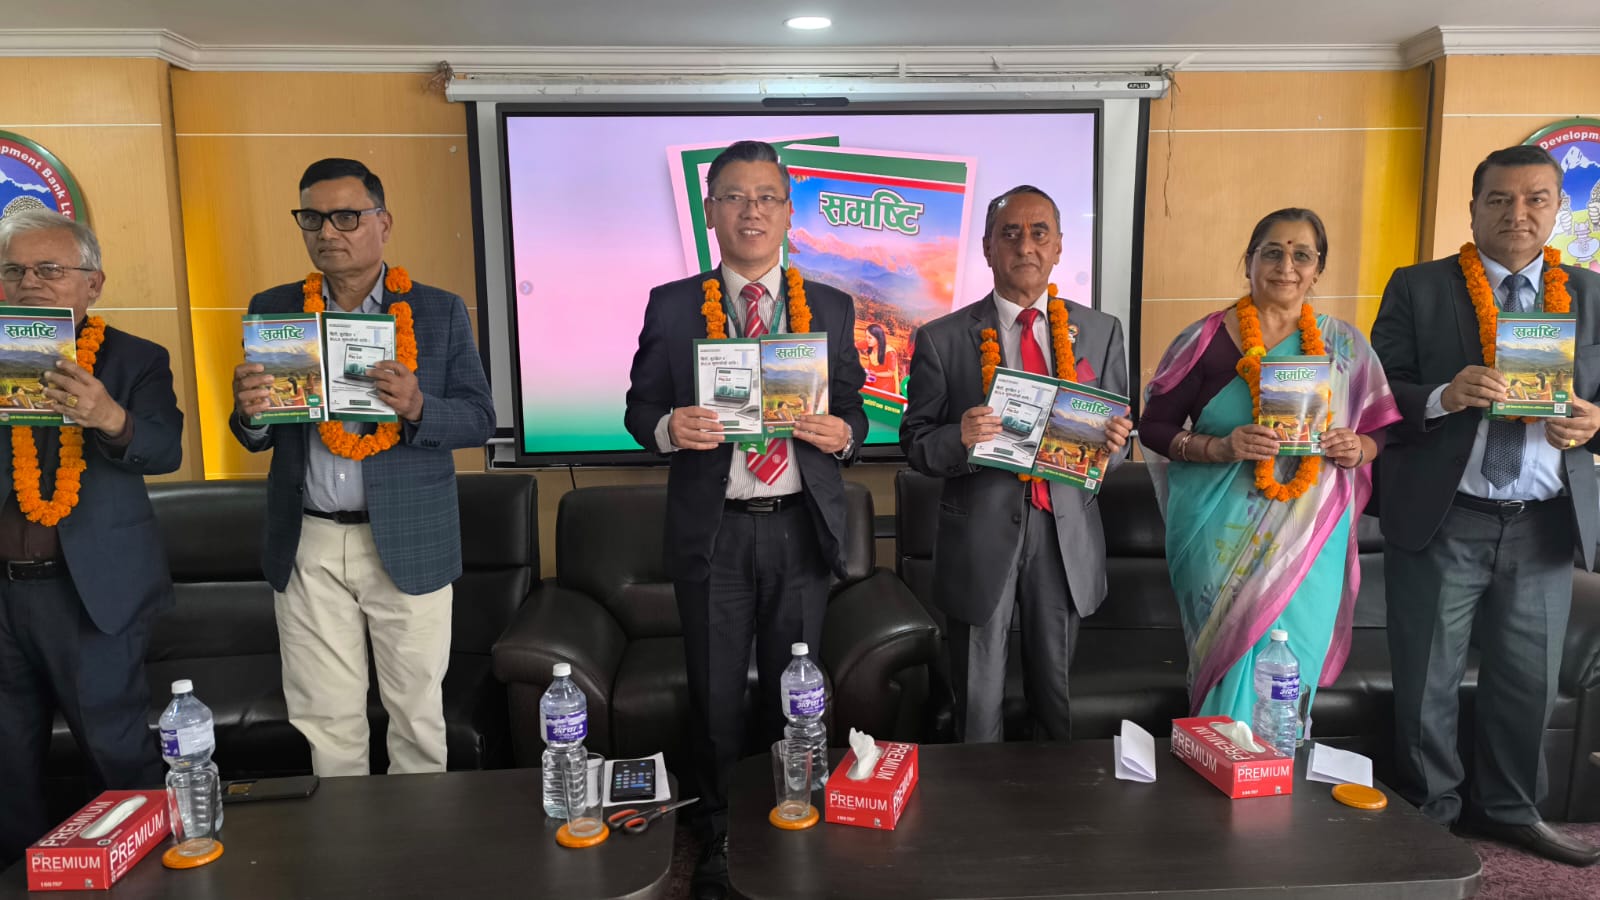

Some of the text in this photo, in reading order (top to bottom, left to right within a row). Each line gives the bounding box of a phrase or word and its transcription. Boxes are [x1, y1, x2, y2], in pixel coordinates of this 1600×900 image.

[1540, 131, 1600, 150] Developm
[0, 145, 72, 219] pment Bank Lt
[819, 189, 923, 235] समष्टि
[4, 321, 57, 339] समष्टि
[259, 324, 304, 342] समष्टि
[1513, 323, 1561, 339] समष्टि
[776, 343, 816, 360] समष्टि
[1275, 367, 1316, 382] समष्टि
[1071, 397, 1113, 417] समष्टि
[1172, 728, 1217, 774] PREMIUM
[1192, 725, 1256, 761] PREMIUM
[875, 743, 910, 780] PREMIUM
[1237, 765, 1290, 780] PREMIUM
[829, 793, 888, 811] PREMIUM
[40, 800, 114, 847] PREMIUM
[109, 809, 165, 871] PREMIUM
[31, 856, 101, 870] PREMIUM
